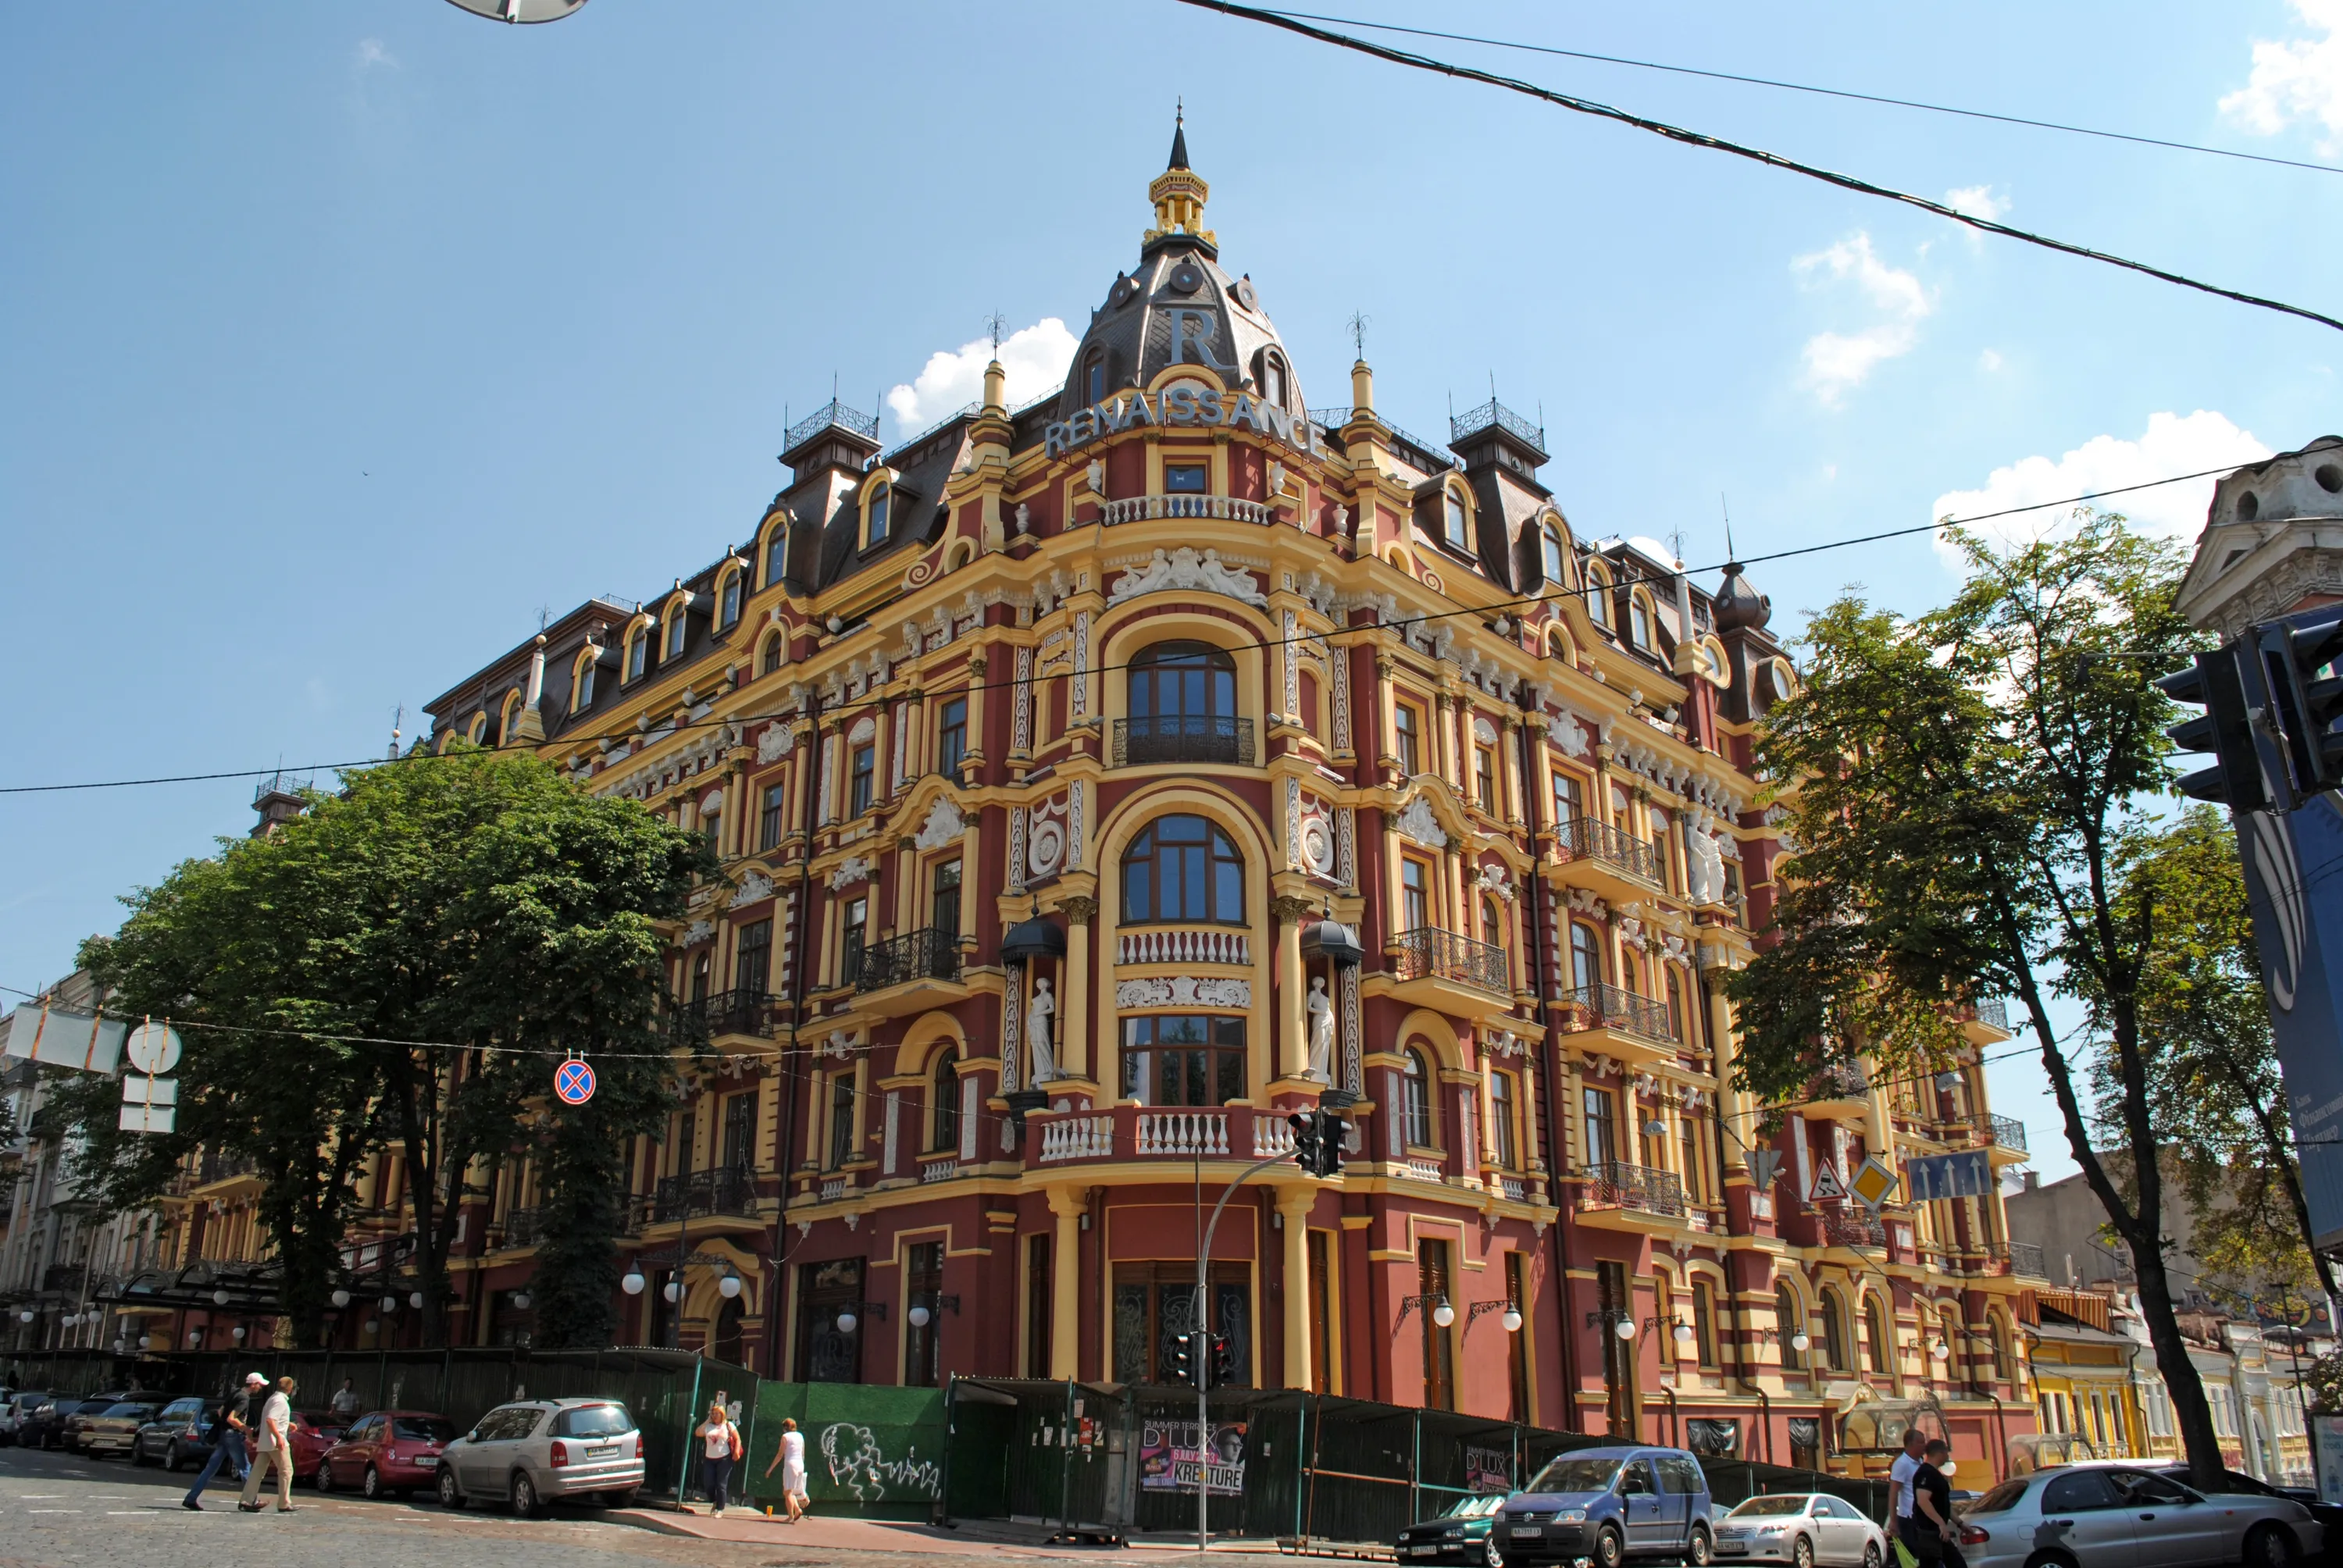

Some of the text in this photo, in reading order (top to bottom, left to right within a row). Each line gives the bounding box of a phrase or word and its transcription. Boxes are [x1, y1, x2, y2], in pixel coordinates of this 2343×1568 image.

[1164, 308, 1238, 373] R
[1044, 388, 1328, 462] RENAISSANCE
[1144, 1420, 1217, 1431] SUMMER TERRCE
[1174, 1449, 1179, 1460] 6
[1179, 1449, 1196, 1461] JULY
[1196, 1451, 1215, 1463] 213
[1175, 1462, 1241, 1488] KRETURE
